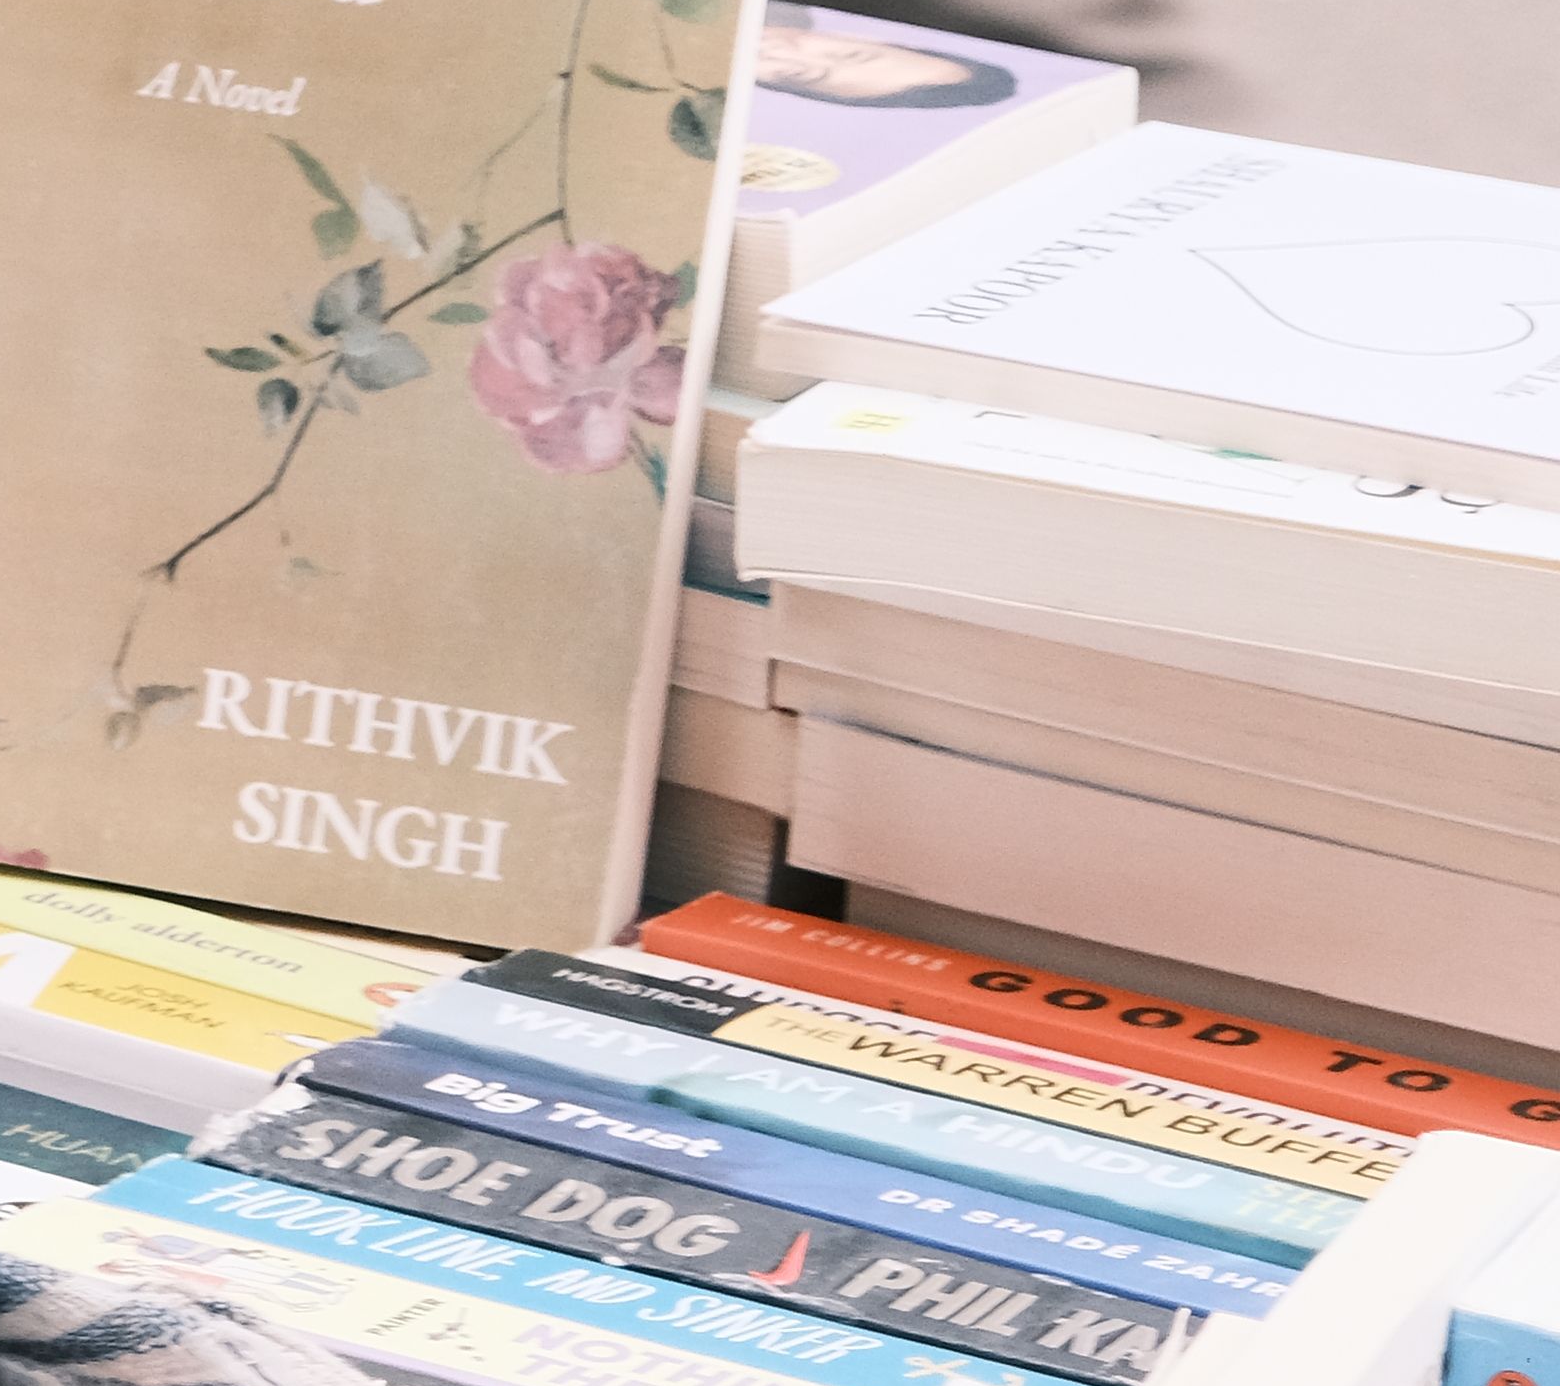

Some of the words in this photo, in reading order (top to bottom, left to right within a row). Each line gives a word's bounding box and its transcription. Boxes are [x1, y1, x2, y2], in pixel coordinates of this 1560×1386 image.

[137, 62, 179, 101] A
[187, 65, 307, 118] Novel
[196, 667, 576, 787] RITHVIK
[233, 781, 510, 882] SINGH
[845, 1031, 1159, 1122] WARREN
[967, 968, 1263, 1050] GOOD
[1323, 1050, 1451, 1096] TO
[423, 1072, 543, 1115] Big
[546, 1101, 724, 1159] Trust
[877, 1188, 956, 1216] DR
[939, 1112, 1221, 1196] HINDU
[277, 1118, 533, 1210] SHOE
[523, 1176, 741, 1261] DOG
[844, 1253, 1040, 1339] PHIL
[523, 1263, 639, 1309] AND
[634, 1289, 885, 1368] SINKER
